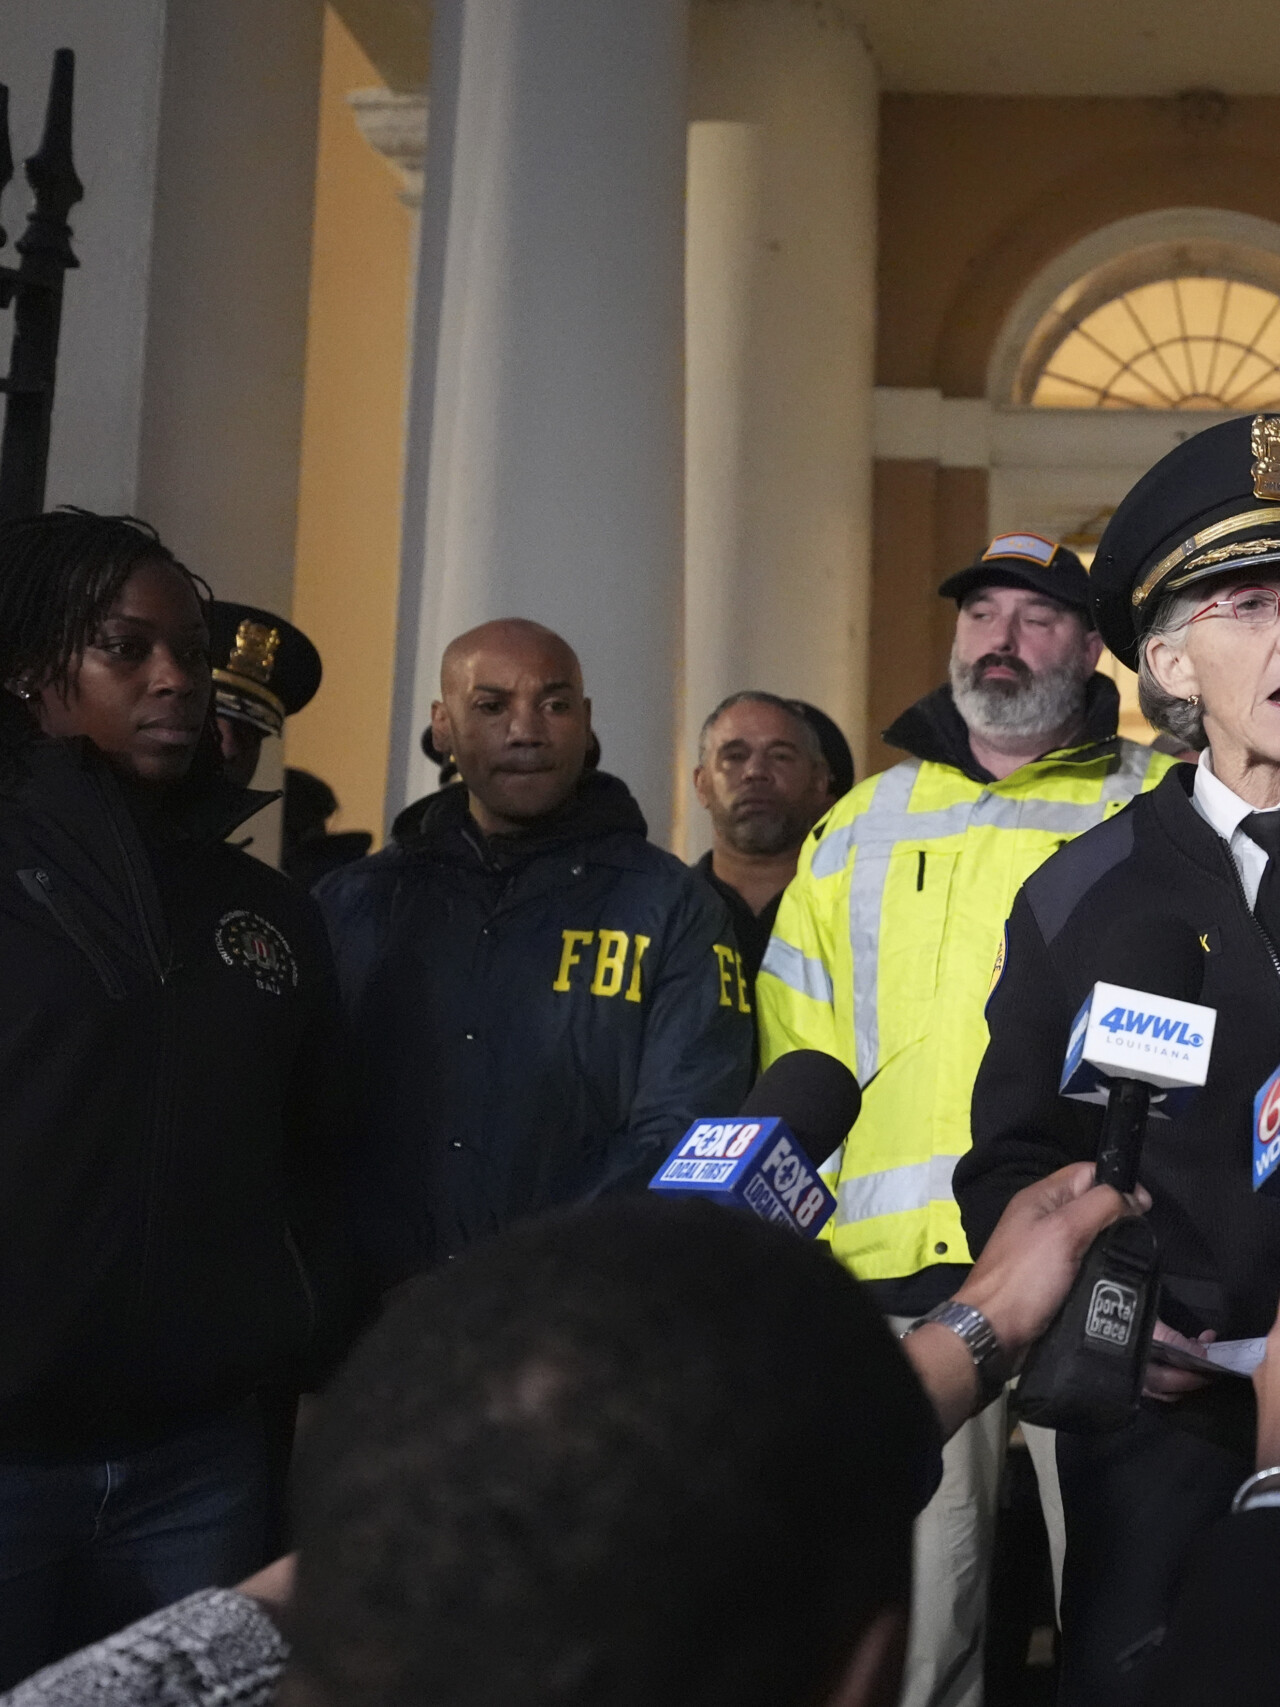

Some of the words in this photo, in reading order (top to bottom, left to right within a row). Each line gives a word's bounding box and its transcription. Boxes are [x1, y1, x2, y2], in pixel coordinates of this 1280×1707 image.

[552, 929, 651, 1003] FBI
[1099, 1006, 1190, 1046] 4WWL
[1106, 1035, 1190, 1061] LOUISIANA
[664, 1161, 700, 1180] LOCAL
[698, 1161, 735, 1181] FIRST
[1090, 1316, 1127, 1341] brace
